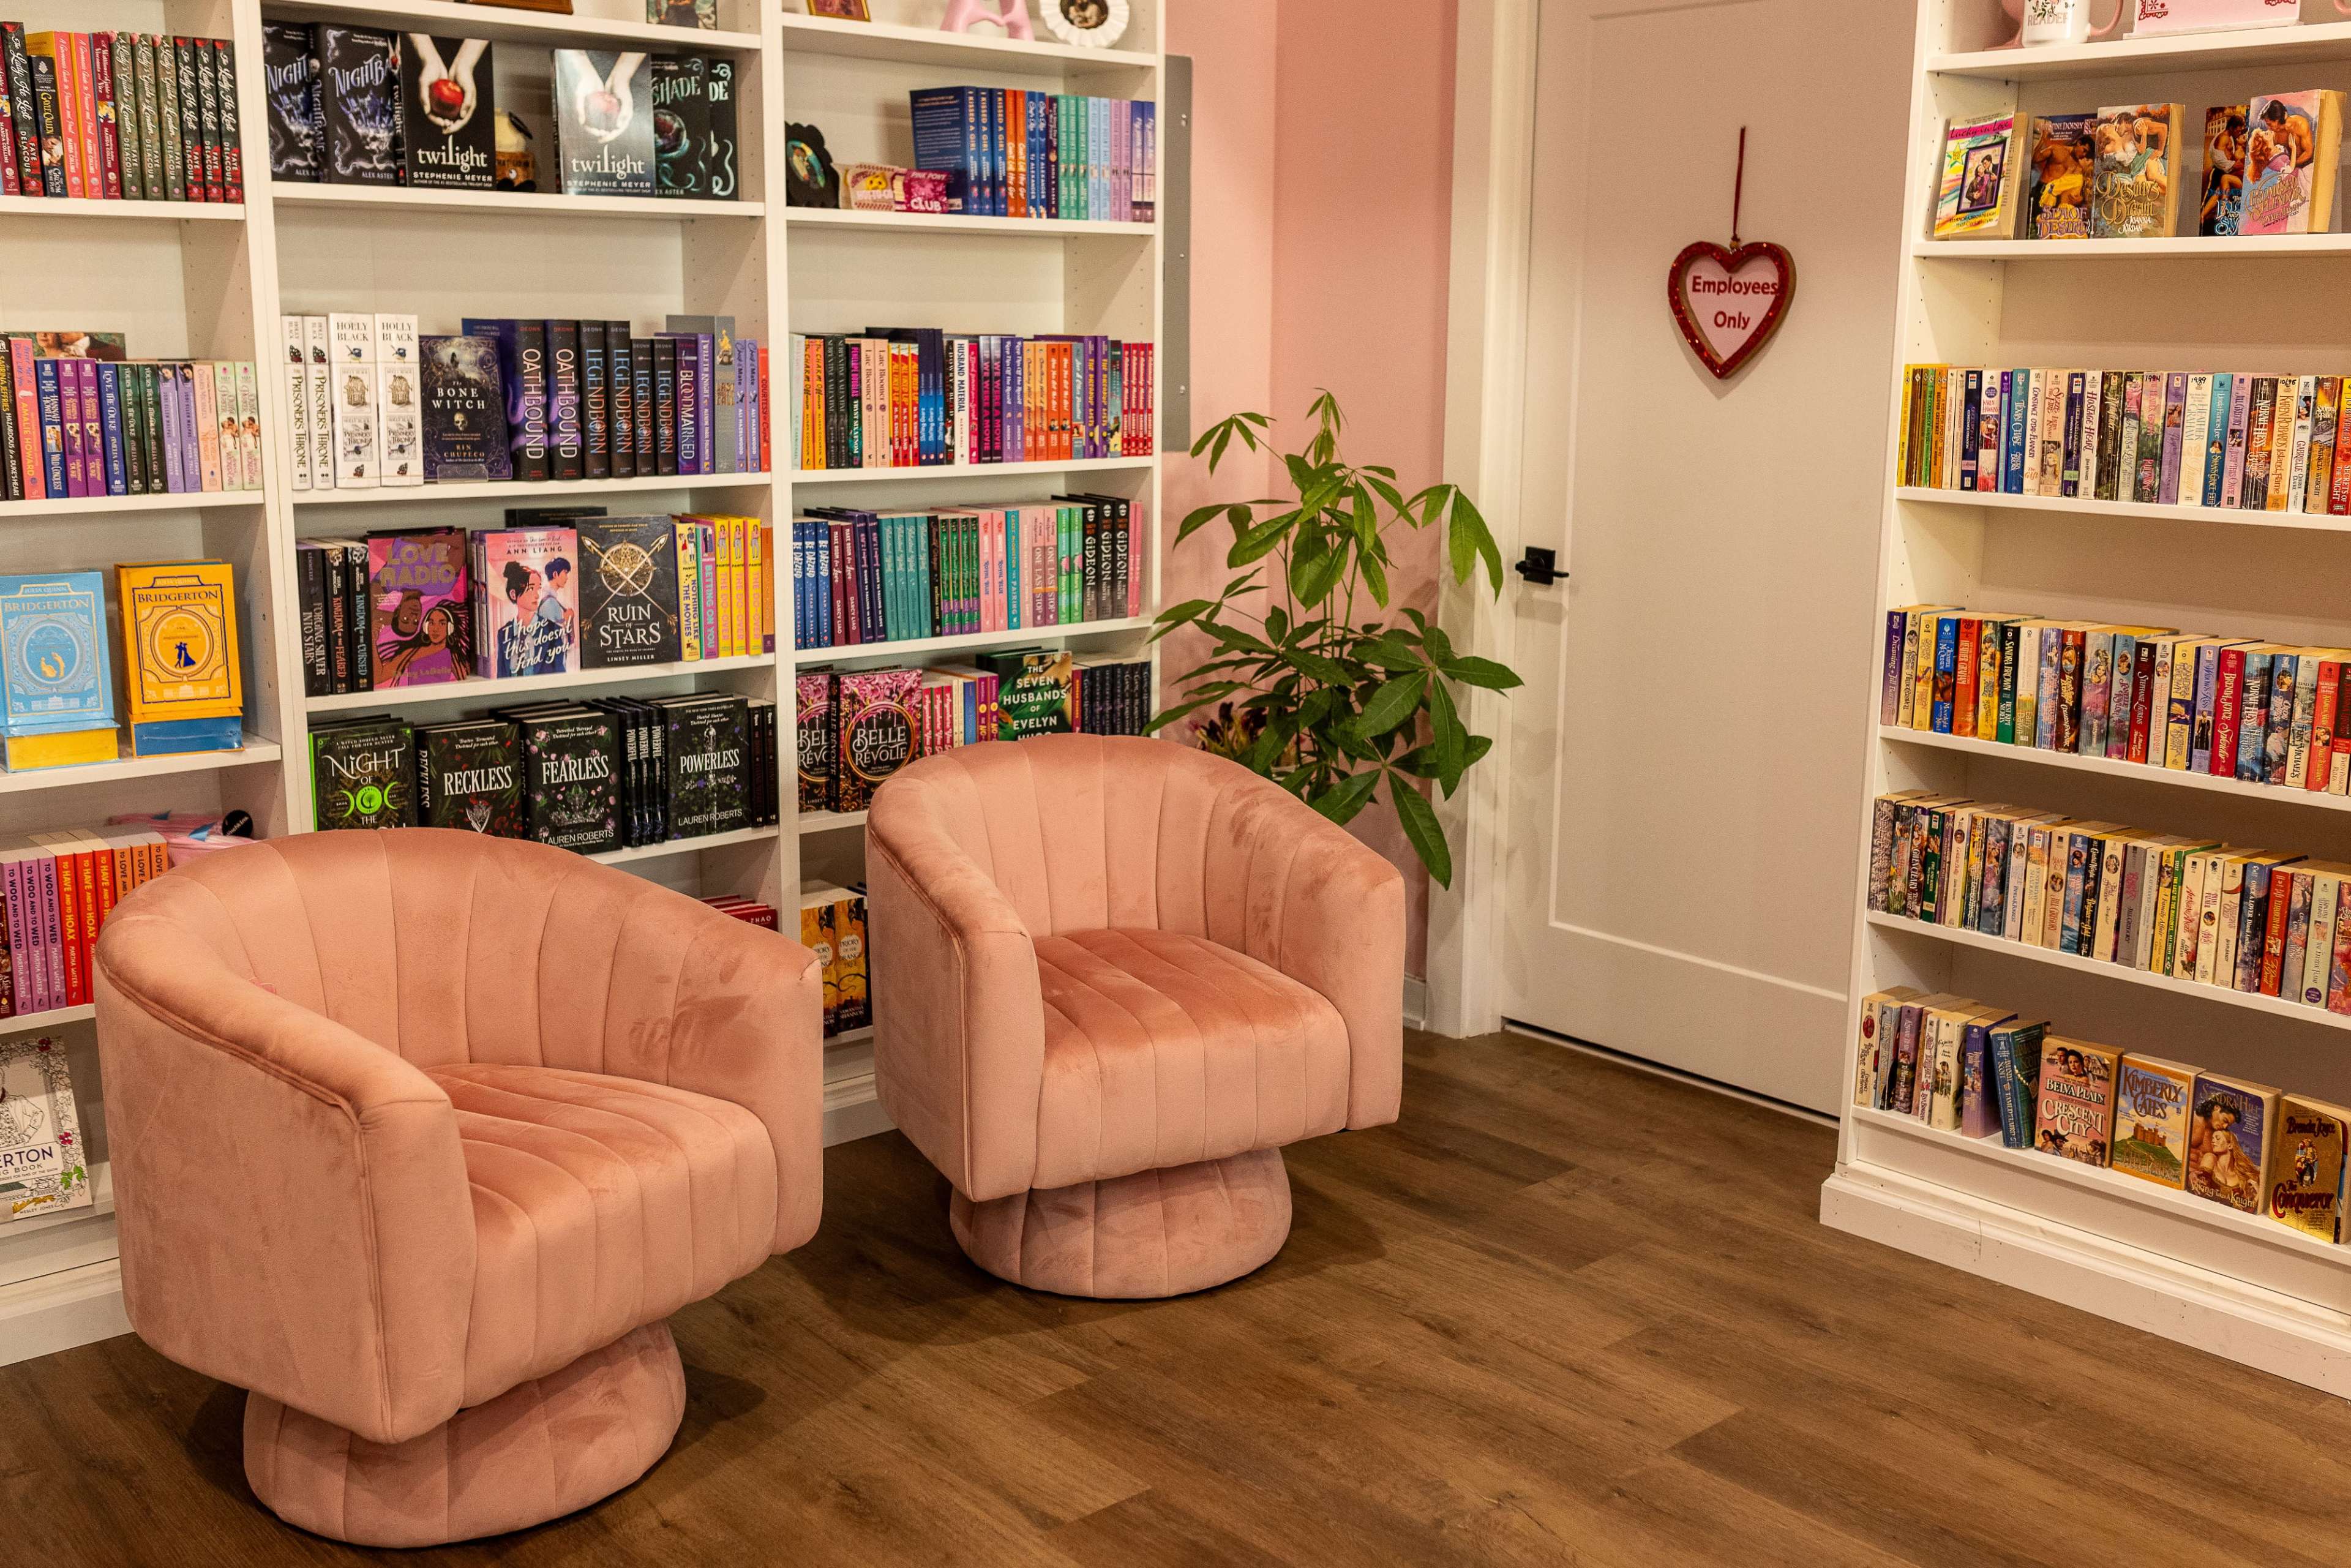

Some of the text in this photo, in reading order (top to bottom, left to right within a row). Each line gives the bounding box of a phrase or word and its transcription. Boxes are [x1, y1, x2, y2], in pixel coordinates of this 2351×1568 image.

[17, 97, 32, 121] Lost
[392, 85, 402, 133] twilight
[21, 130, 31, 173] DELACOUR
[417, 135, 487, 172] twilight
[572, 144, 645, 179] twilight
[413, 172, 461, 181] STEPHENIE
[910, 199, 942, 212] CLUB
[2128, 216, 2152, 225] JOANNA
[1692, 276, 1778, 296] Employees
[1714, 311, 1750, 330] Only
[338, 332, 369, 342] BLACK
[432, 399, 486, 410] WITCH
[437, 388, 478, 397] BONE
[522, 348, 544, 459] OATHBOUND
[555, 348, 577, 459] OATHBOUND
[585, 349, 607, 455] LEGENDBORN
[613, 350, 632, 454] LEGENDBORN
[636, 370, 651, 454] LEGENDBORN
[658, 370, 673, 454] LEGENDBORN
[680, 370, 695, 459] BLOODMARKED
[2279, 396, 2293, 418] KAREN
[7, 413, 15, 448] HAZARDOUS
[2083, 391, 2097, 453] HOSTAGE HEART
[2252, 400, 2271, 447] NORAH HESS
[2276, 418, 2292, 447] ROBARDS
[21, 402, 34, 476] AMALIE HOWARD
[296, 433, 306, 468] THRONE
[2274, 449, 2285, 473] Island
[2294, 441, 2306, 472] GABRIELLE
[2333, 478, 2341, 501] NIGHT
[2341, 465, 2351, 494] SECRETS
[385, 543, 449, 565] LOVE
[380, 564, 456, 587] RADIO
[4, 598, 89, 612] BRIDGERTON
[138, 590, 219, 603] BRIDGERTON
[302, 612, 311, 634] INTO
[607, 604, 651, 623] RUIN
[707, 609, 713, 624] ON
[504, 617, 572, 661] this doesn't
[517, 618, 548, 640] hope
[600, 622, 661, 648] STARS
[315, 640, 325, 676] SILVER
[515, 644, 571, 673] find you
[2003, 640, 2014, 691] SANDRA BROWN
[1016, 676, 1054, 688] SEVEN
[1003, 689, 1067, 705] HUSBANDS
[2134, 672, 2148, 725] STEPHANIE LAURENS
[2222, 700, 2232, 720] JOYCE
[1013, 716, 1057, 730] EVELYN
[626, 729, 637, 762] POWERFUL
[639, 727, 649, 759] POWERFUL
[651, 726, 662, 758] POWERFUL
[853, 726, 906, 752] BELLE
[2218, 723, 2233, 763] Splendor
[680, 749, 740, 773] POWERLESS
[855, 741, 909, 768] RÉVOLTE
[361, 776, 373, 785] OF
[444, 766, 512, 795] RECKLESS
[542, 755, 609, 785] FEARLESS
[362, 816, 377, 825] THE
[678, 808, 743, 826] LAUREN ROBERTS
[577, 829, 613, 841] ROBERTS
[8, 868, 14, 877] TO
[9, 879, 18, 903] WOO
[63, 861, 69, 870] TO
[66, 915, 75, 940] HOAX
[13, 919, 20, 931] TO
[2045, 1078, 2105, 1105] BELVA PLAIN
[2121, 1066, 2184, 1103] KIMBERLY
[2041, 1098, 2105, 1136] CRESCENT
[2132, 1089, 2167, 1120] CATES
[2055, 1114, 2090, 1138] CITY
[2286, 1117, 2336, 1138] Brenda Joyce
[14, 1163, 43, 1173] BOOK
[2272, 1184, 2334, 1219] Conqueror
